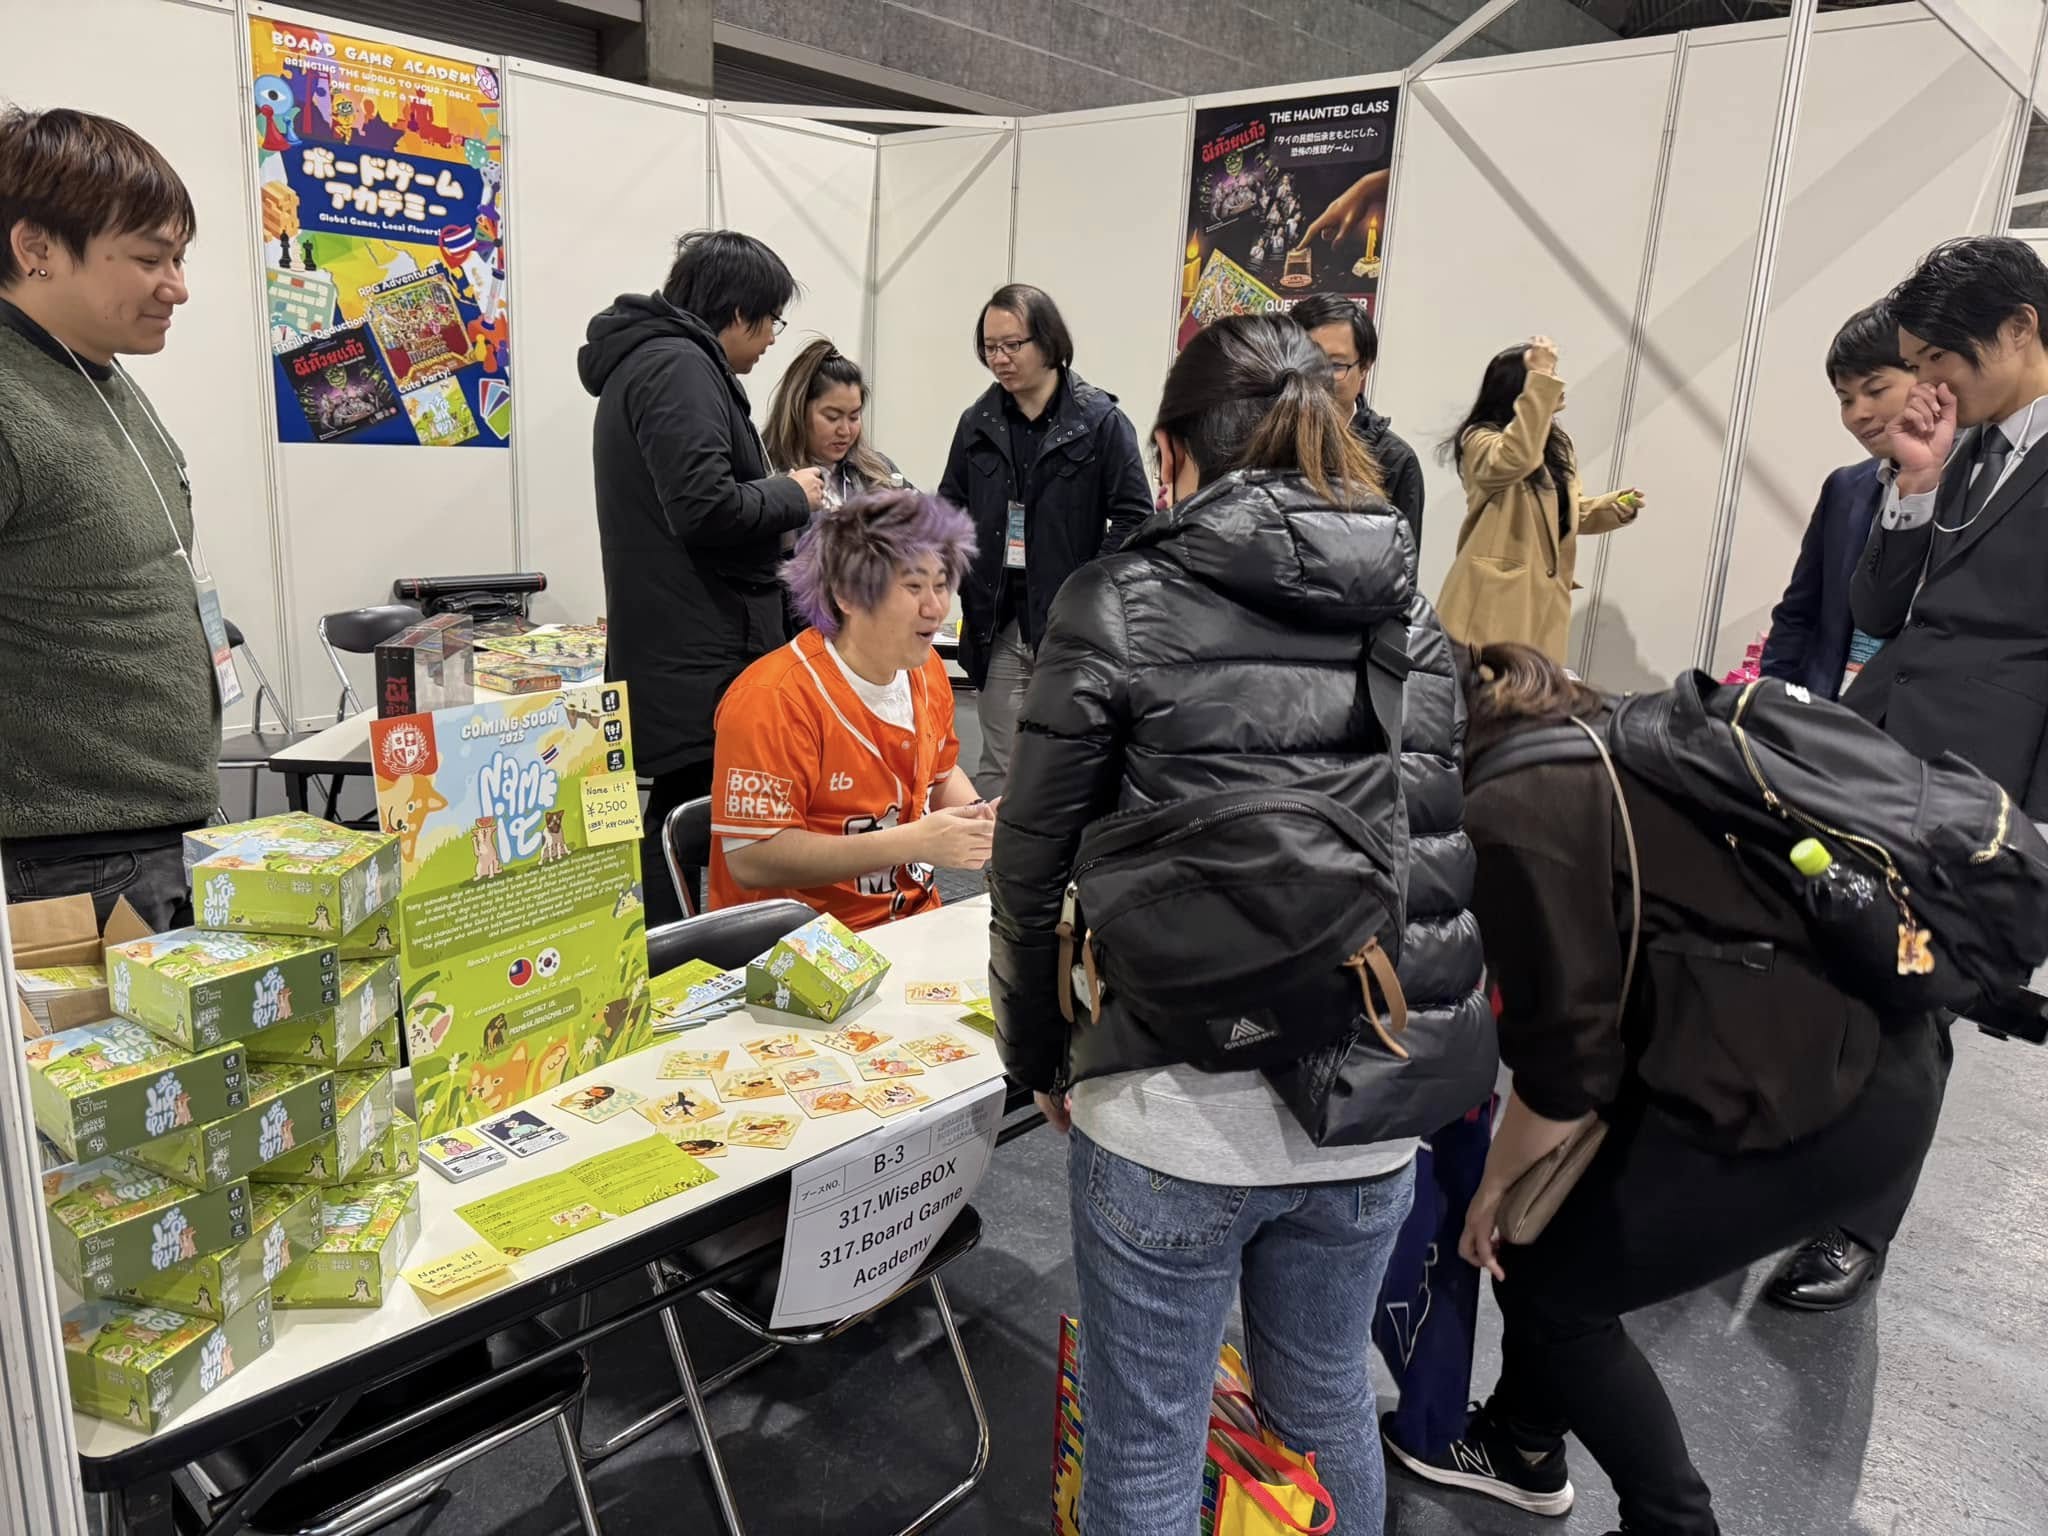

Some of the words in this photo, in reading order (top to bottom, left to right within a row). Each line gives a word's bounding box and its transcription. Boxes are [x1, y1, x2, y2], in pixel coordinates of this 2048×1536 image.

[272, 31, 336, 56] BOARD
[345, 46, 394, 69] GAME
[404, 59, 481, 87] ACADEMY
[285, 57, 337, 74] BRINGING
[339, 67, 360, 78] THE
[362, 72, 396, 85] WORLD
[399, 80, 412, 89] TO
[415, 84, 440, 94] YOUR
[332, 80, 352, 91] ONE
[354, 85, 381, 96] GAME
[384, 91, 397, 99] AT
[399, 93, 406, 101] A
[1270, 111, 1292, 124] THE
[1294, 105, 1349, 121] HAUNTED
[1352, 100, 1390, 115] GLASS
[302, 147, 464, 200] ボードゲーム
[325, 181, 448, 221] アカデミー
[319, 213, 348, 225] Global
[382, 221, 406, 232] Local
[358, 285, 380, 298] RPG
[382, 266, 438, 291] Adventure!
[273, 335, 314, 353] Thriller
[399, 379, 422, 394] Cute
[422, 368, 452, 388] Party!
[462, 717, 519, 739] COMING
[522, 710, 558, 729] SOON
[499, 731, 526, 746] 2025
[586, 786, 608, 796] Name
[728, 795, 791, 816] BREW
[874, 1145, 905, 1175] B-3
[801, 1178, 841, 1201] ブースNO.
[839, 1157, 957, 1230] 317.WiseBOX
[819, 1212, 914, 1270] 317.Board
[919, 1186, 963, 1222] Game
[418, 1263, 453, 1279] Name
[853, 1234, 932, 1288] Academy
